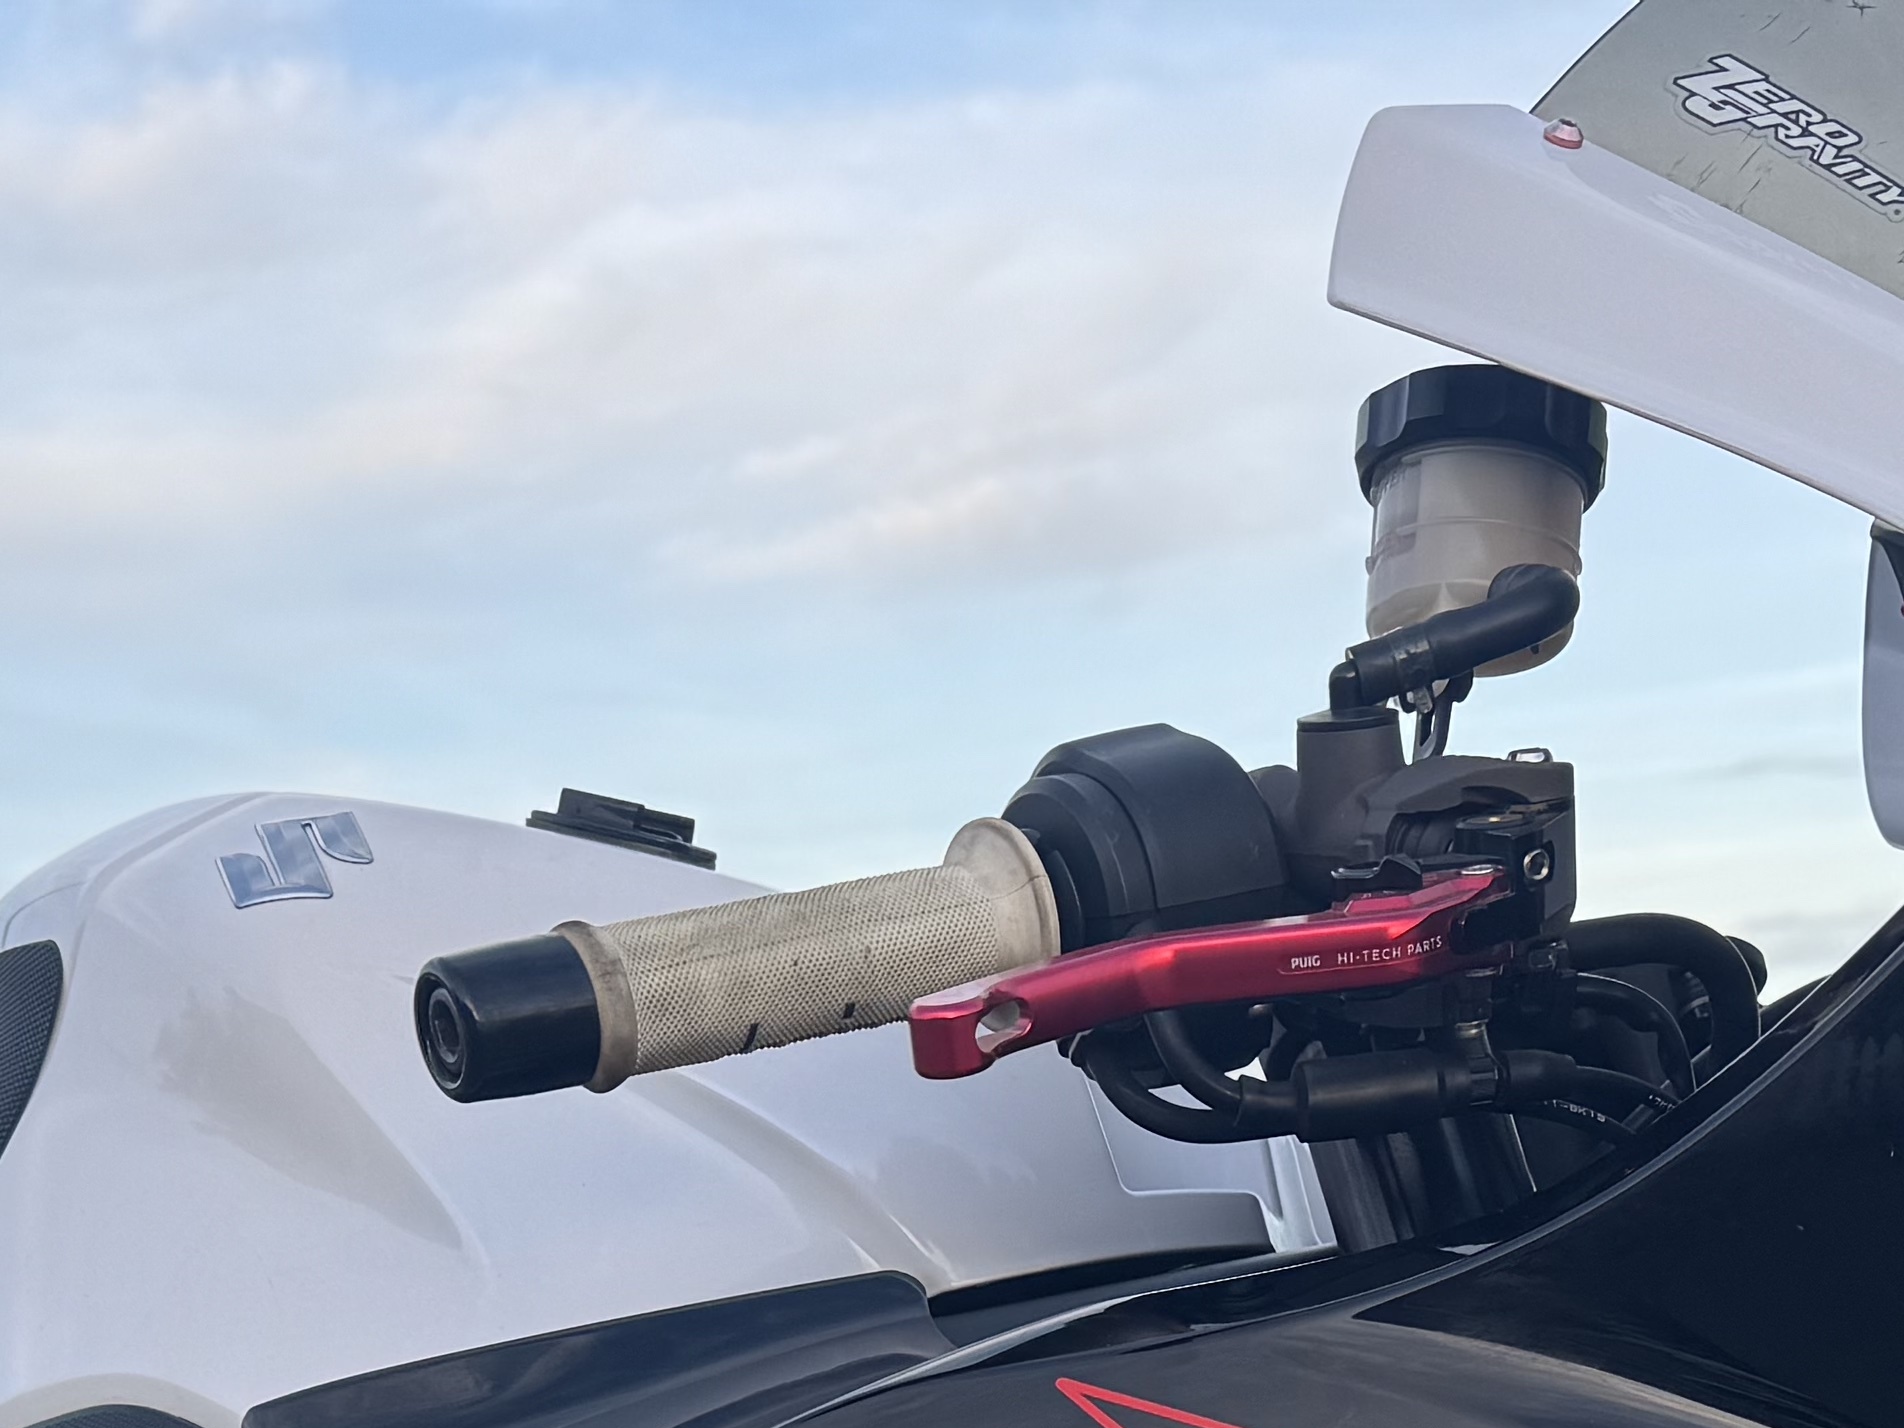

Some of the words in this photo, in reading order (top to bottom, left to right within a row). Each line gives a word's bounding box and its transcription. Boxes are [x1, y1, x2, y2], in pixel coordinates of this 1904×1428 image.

[1673, 54, 1864, 148] ZERO
[1290, 954, 1322, 970] PUIG
[1406, 935, 1443, 956] PARTS
